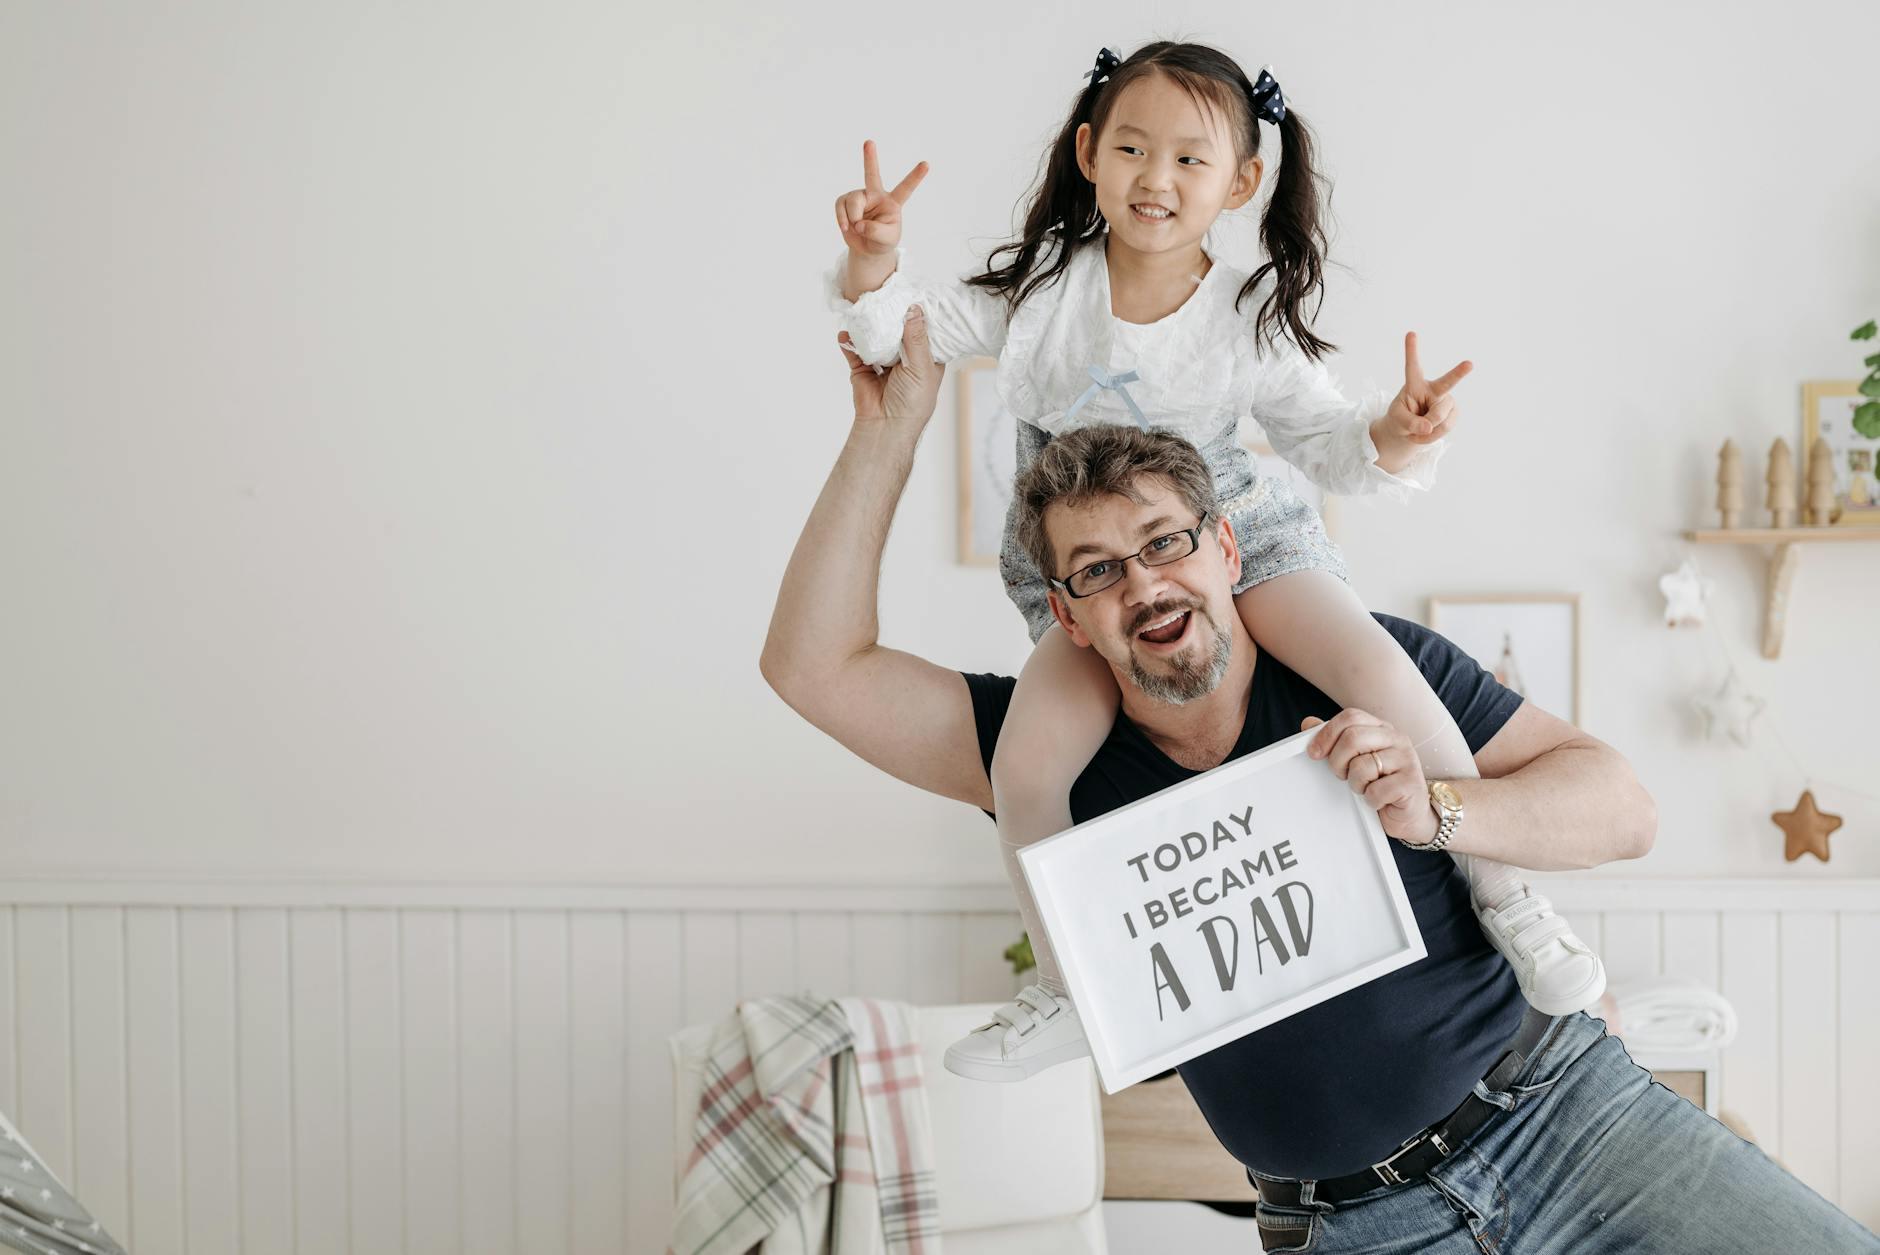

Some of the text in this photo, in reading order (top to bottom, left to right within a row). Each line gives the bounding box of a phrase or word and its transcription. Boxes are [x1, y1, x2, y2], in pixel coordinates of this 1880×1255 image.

[1123, 839, 1298, 939] I BECAME
[1127, 805, 1253, 883] TODAY
[1150, 881, 1314, 1022] A DAD
